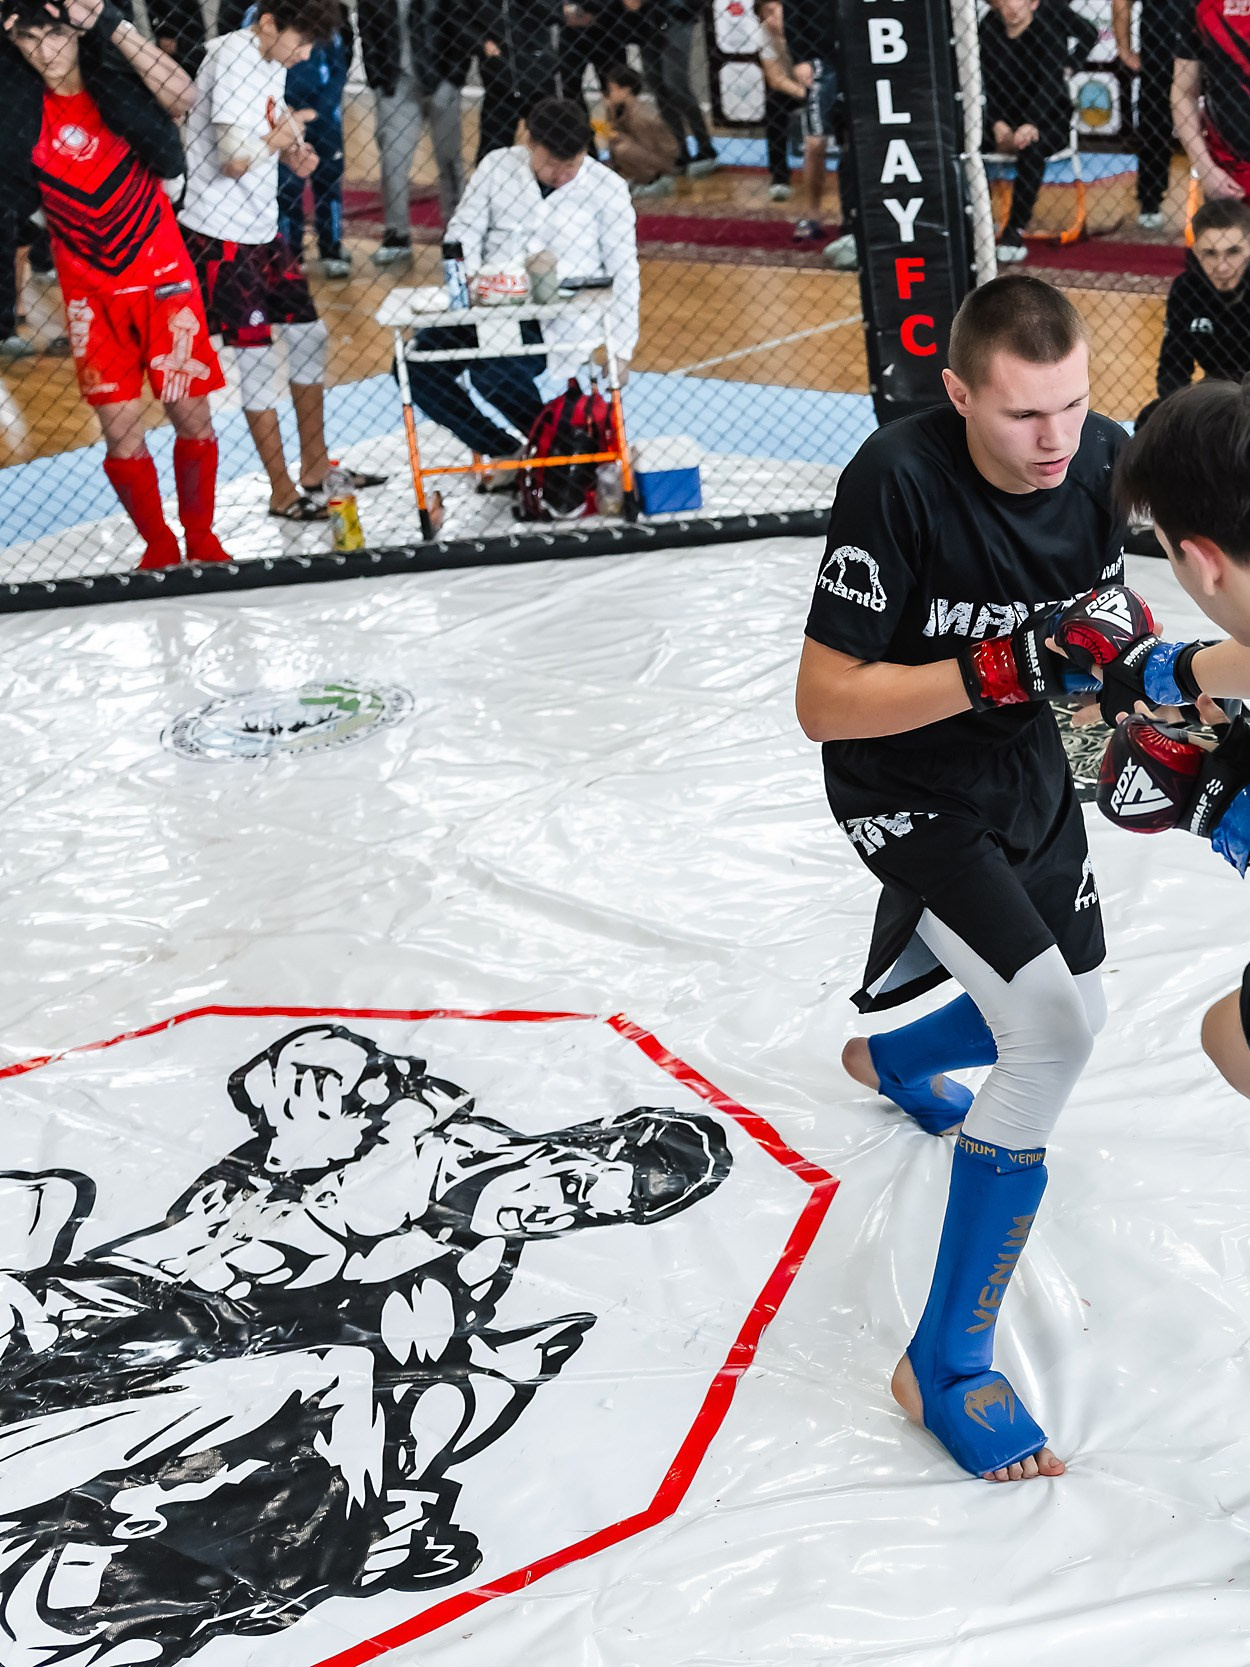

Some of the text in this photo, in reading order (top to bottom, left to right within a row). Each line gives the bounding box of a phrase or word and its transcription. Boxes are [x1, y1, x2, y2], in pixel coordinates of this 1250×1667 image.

[863, 0, 938, 357] BLAY FC
[816, 574, 888, 613] manto
[1085, 586, 1120, 616] RDX
[1110, 756, 1139, 815] RDX
[966, 1214, 1035, 1334] VENUM
